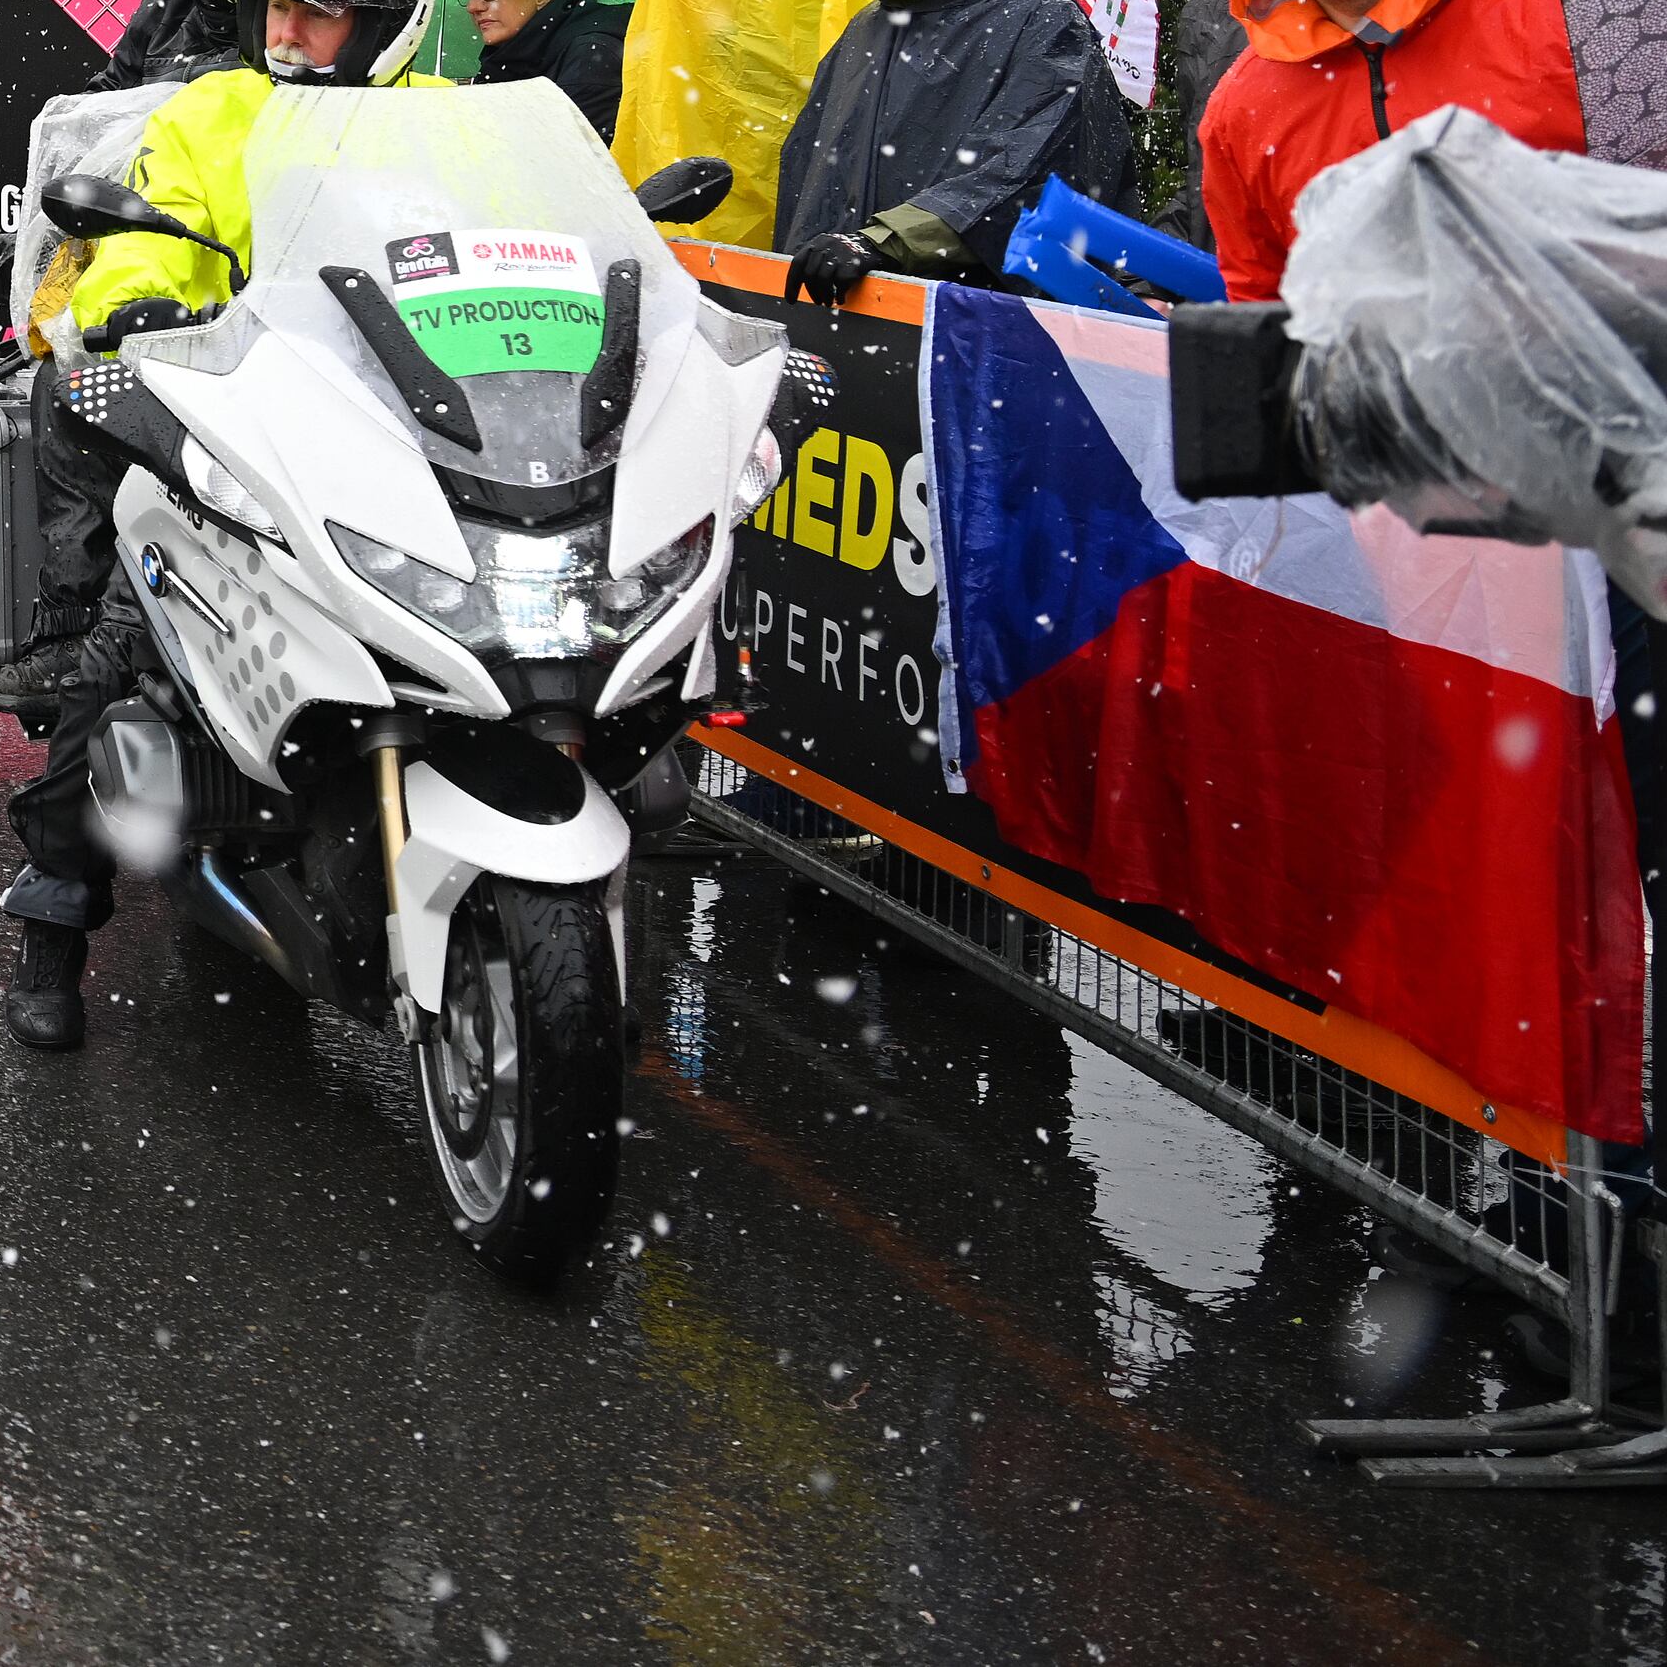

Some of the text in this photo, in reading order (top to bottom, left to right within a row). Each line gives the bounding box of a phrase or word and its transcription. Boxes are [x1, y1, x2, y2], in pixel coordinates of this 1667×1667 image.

[495, 243, 577, 265] YAMAHA
[410, 300, 601, 331] TV PRODUCTION
[500, 332, 534, 355] 13
[529, 461, 550, 483] B
